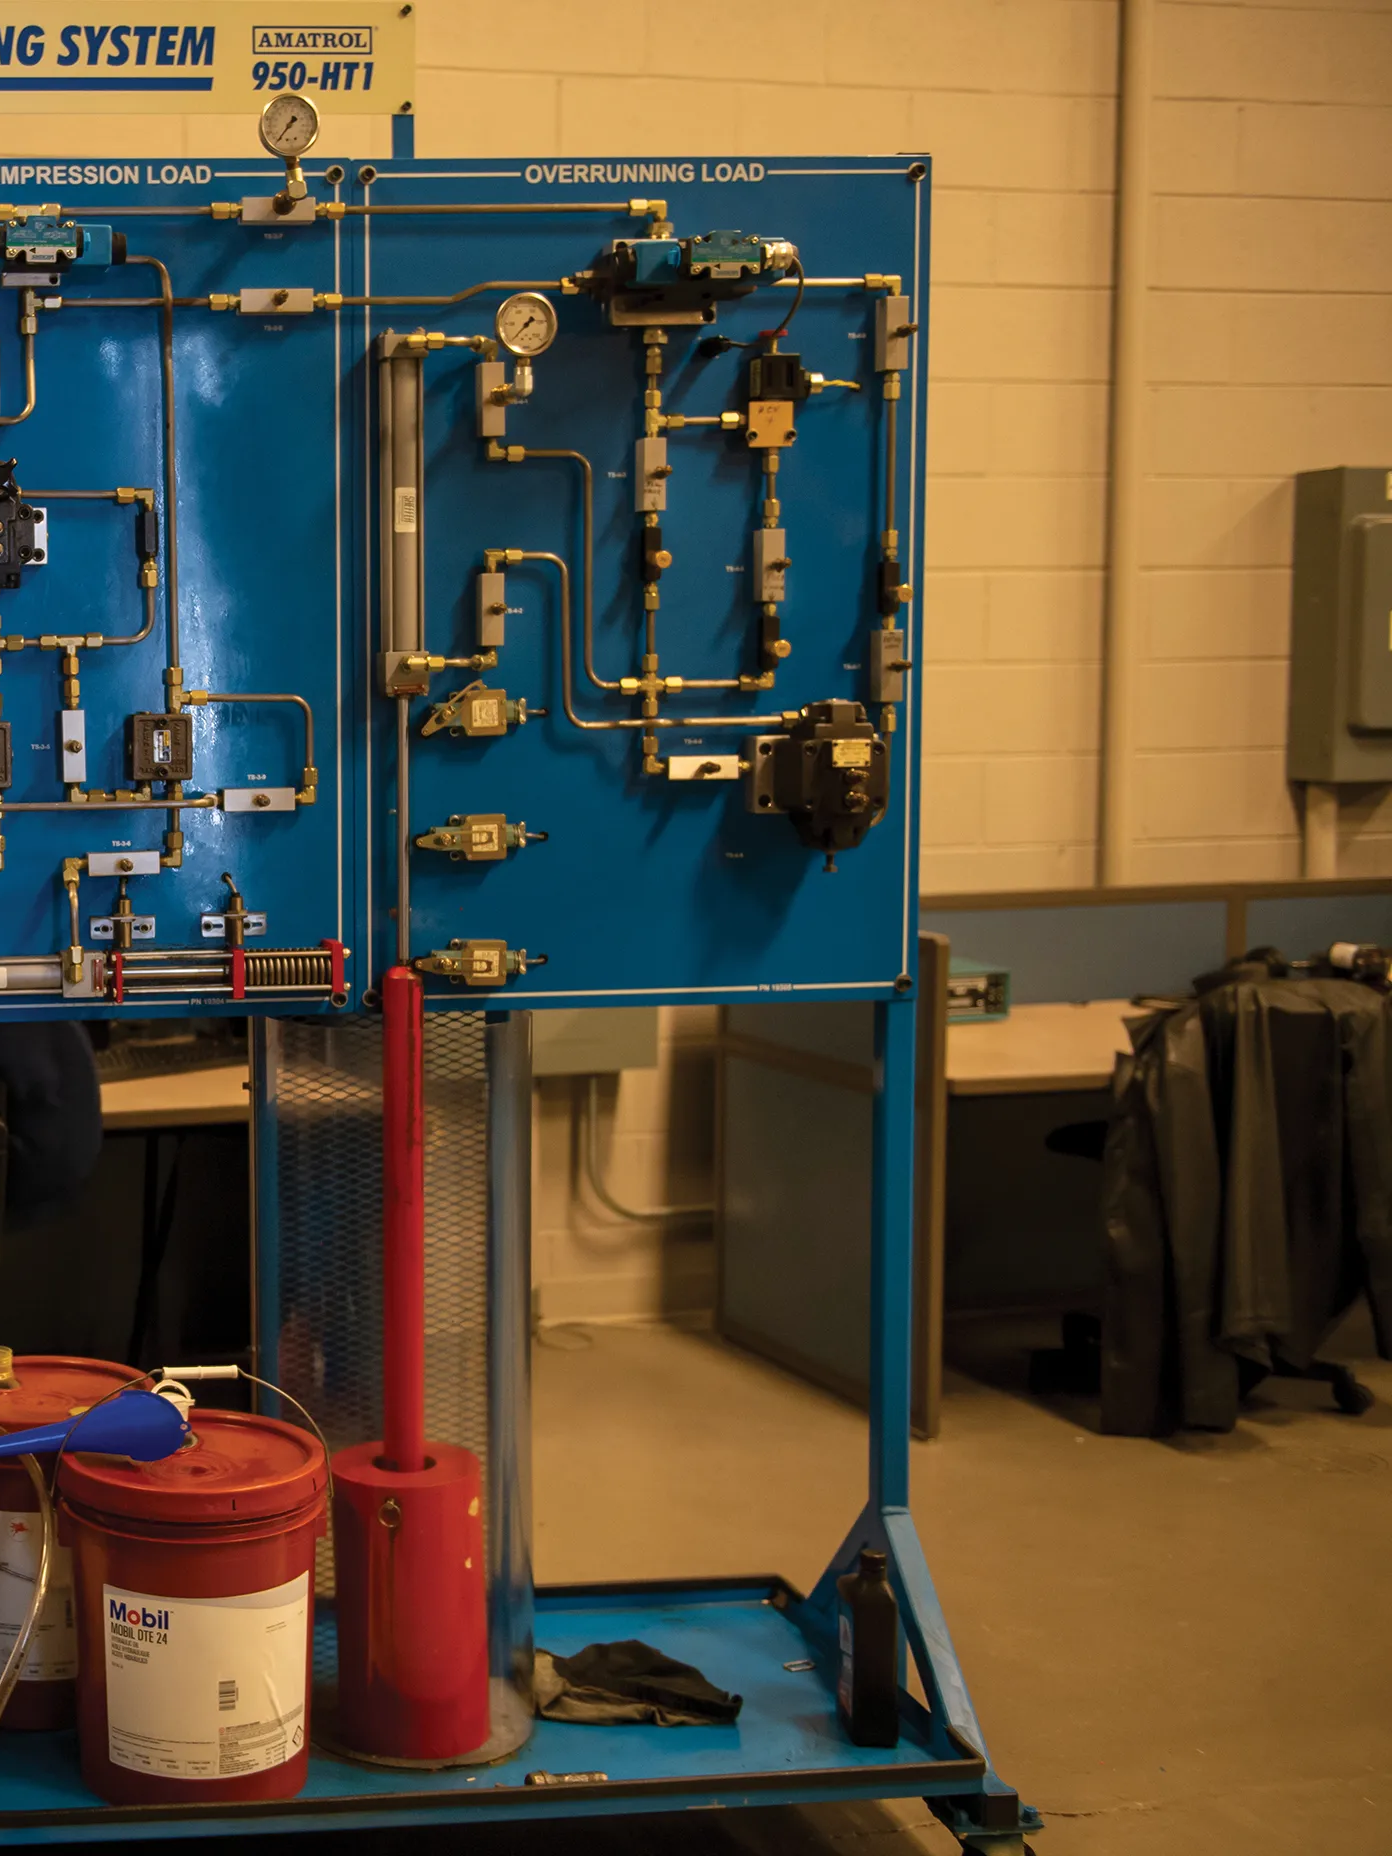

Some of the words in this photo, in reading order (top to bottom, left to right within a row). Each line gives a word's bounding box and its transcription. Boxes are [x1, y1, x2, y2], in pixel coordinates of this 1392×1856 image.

[56, 24, 215, 67] SYSTEM
[258, 31, 366, 49] AMATROL
[251, 61, 375, 92] 950-HT1
[147, 165, 212, 185] LOAD
[524, 163, 695, 184] OVERRUNNING
[702, 162, 765, 183] LOAD
[109, 1599, 169, 1630] Mobil
[110, 1621, 136, 1641] MOBIL
[137, 1629, 154, 1644] DTE
[156, 1631, 168, 1645] 24
